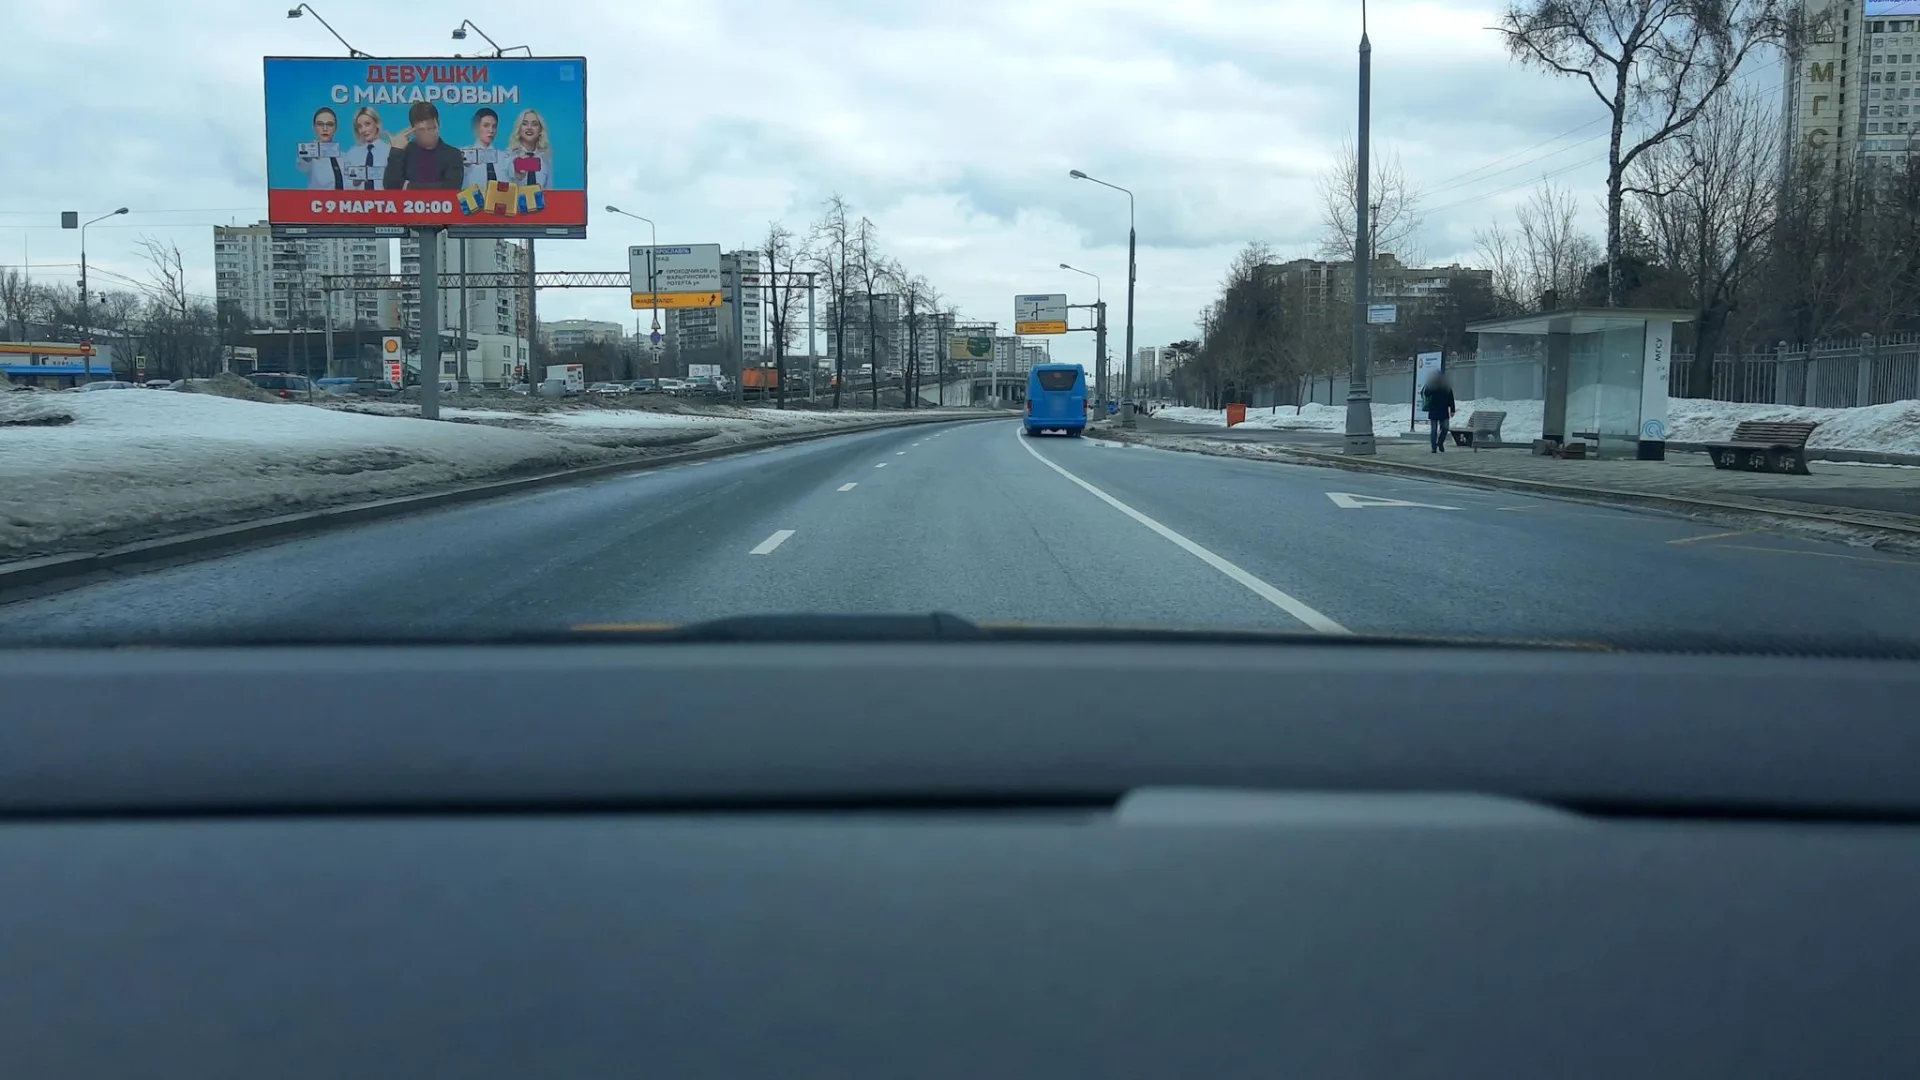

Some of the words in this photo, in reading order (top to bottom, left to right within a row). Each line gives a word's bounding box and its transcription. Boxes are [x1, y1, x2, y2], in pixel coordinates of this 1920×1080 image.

[366, 65, 489, 84] ДЕВУШКИ
[331, 85, 349, 104] С
[354, 85, 520, 104] МАКАРОВЫМ
[311, 200, 322, 213] С
[325, 200, 333, 213] 9
[339, 200, 397, 213] МАРТА
[403, 200, 453, 213] 20:00
[456, 180, 546, 217] ТНТ
